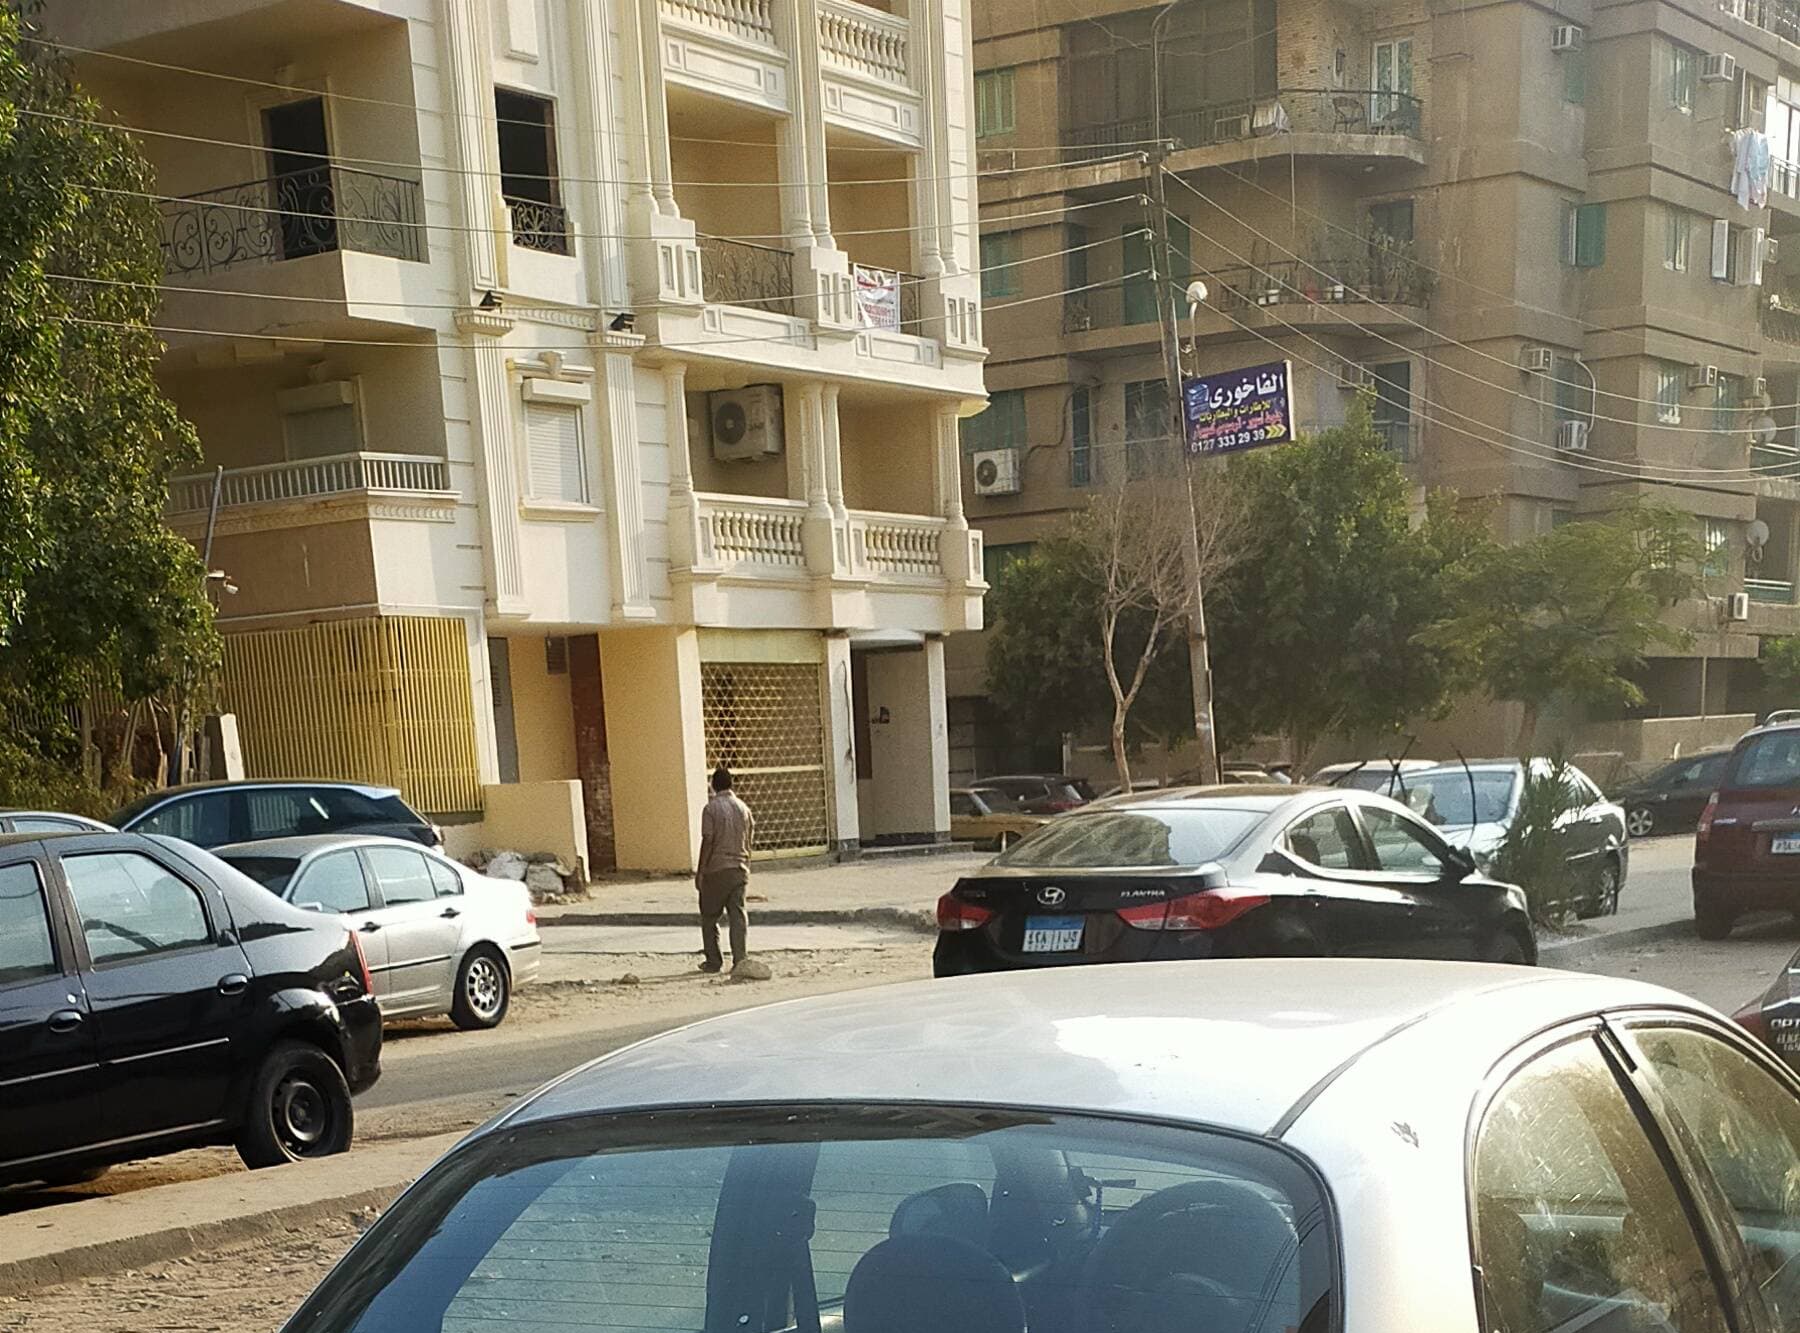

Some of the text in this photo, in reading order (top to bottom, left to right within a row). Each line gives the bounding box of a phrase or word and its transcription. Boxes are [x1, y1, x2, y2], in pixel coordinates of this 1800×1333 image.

[1191, 429, 1265, 453] 0127 333 29 39
